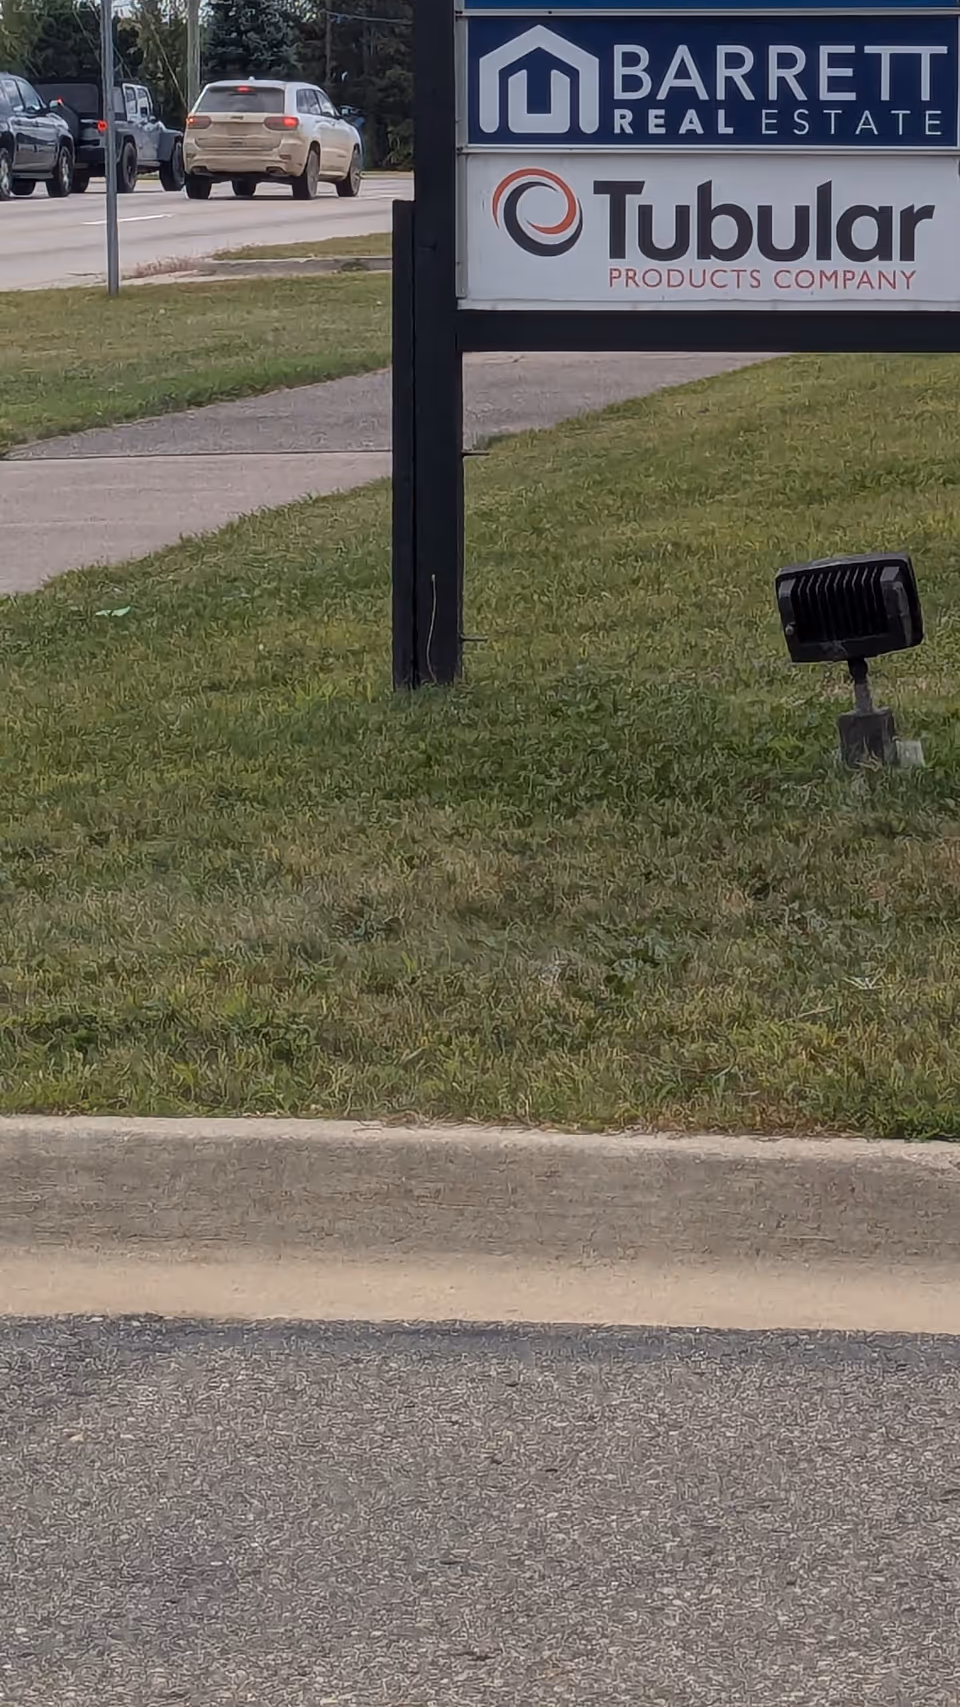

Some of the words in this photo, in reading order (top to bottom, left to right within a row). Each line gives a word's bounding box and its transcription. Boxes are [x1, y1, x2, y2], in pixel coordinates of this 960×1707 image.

[614, 45, 948, 101] BARRETT
[614, 109, 733, 134] REAL
[762, 109, 941, 135] ESTATE
[593, 180, 935, 262] Tubular
[610, 267, 760, 288] PRODUCTS
[773, 270, 916, 290] COMPANY
